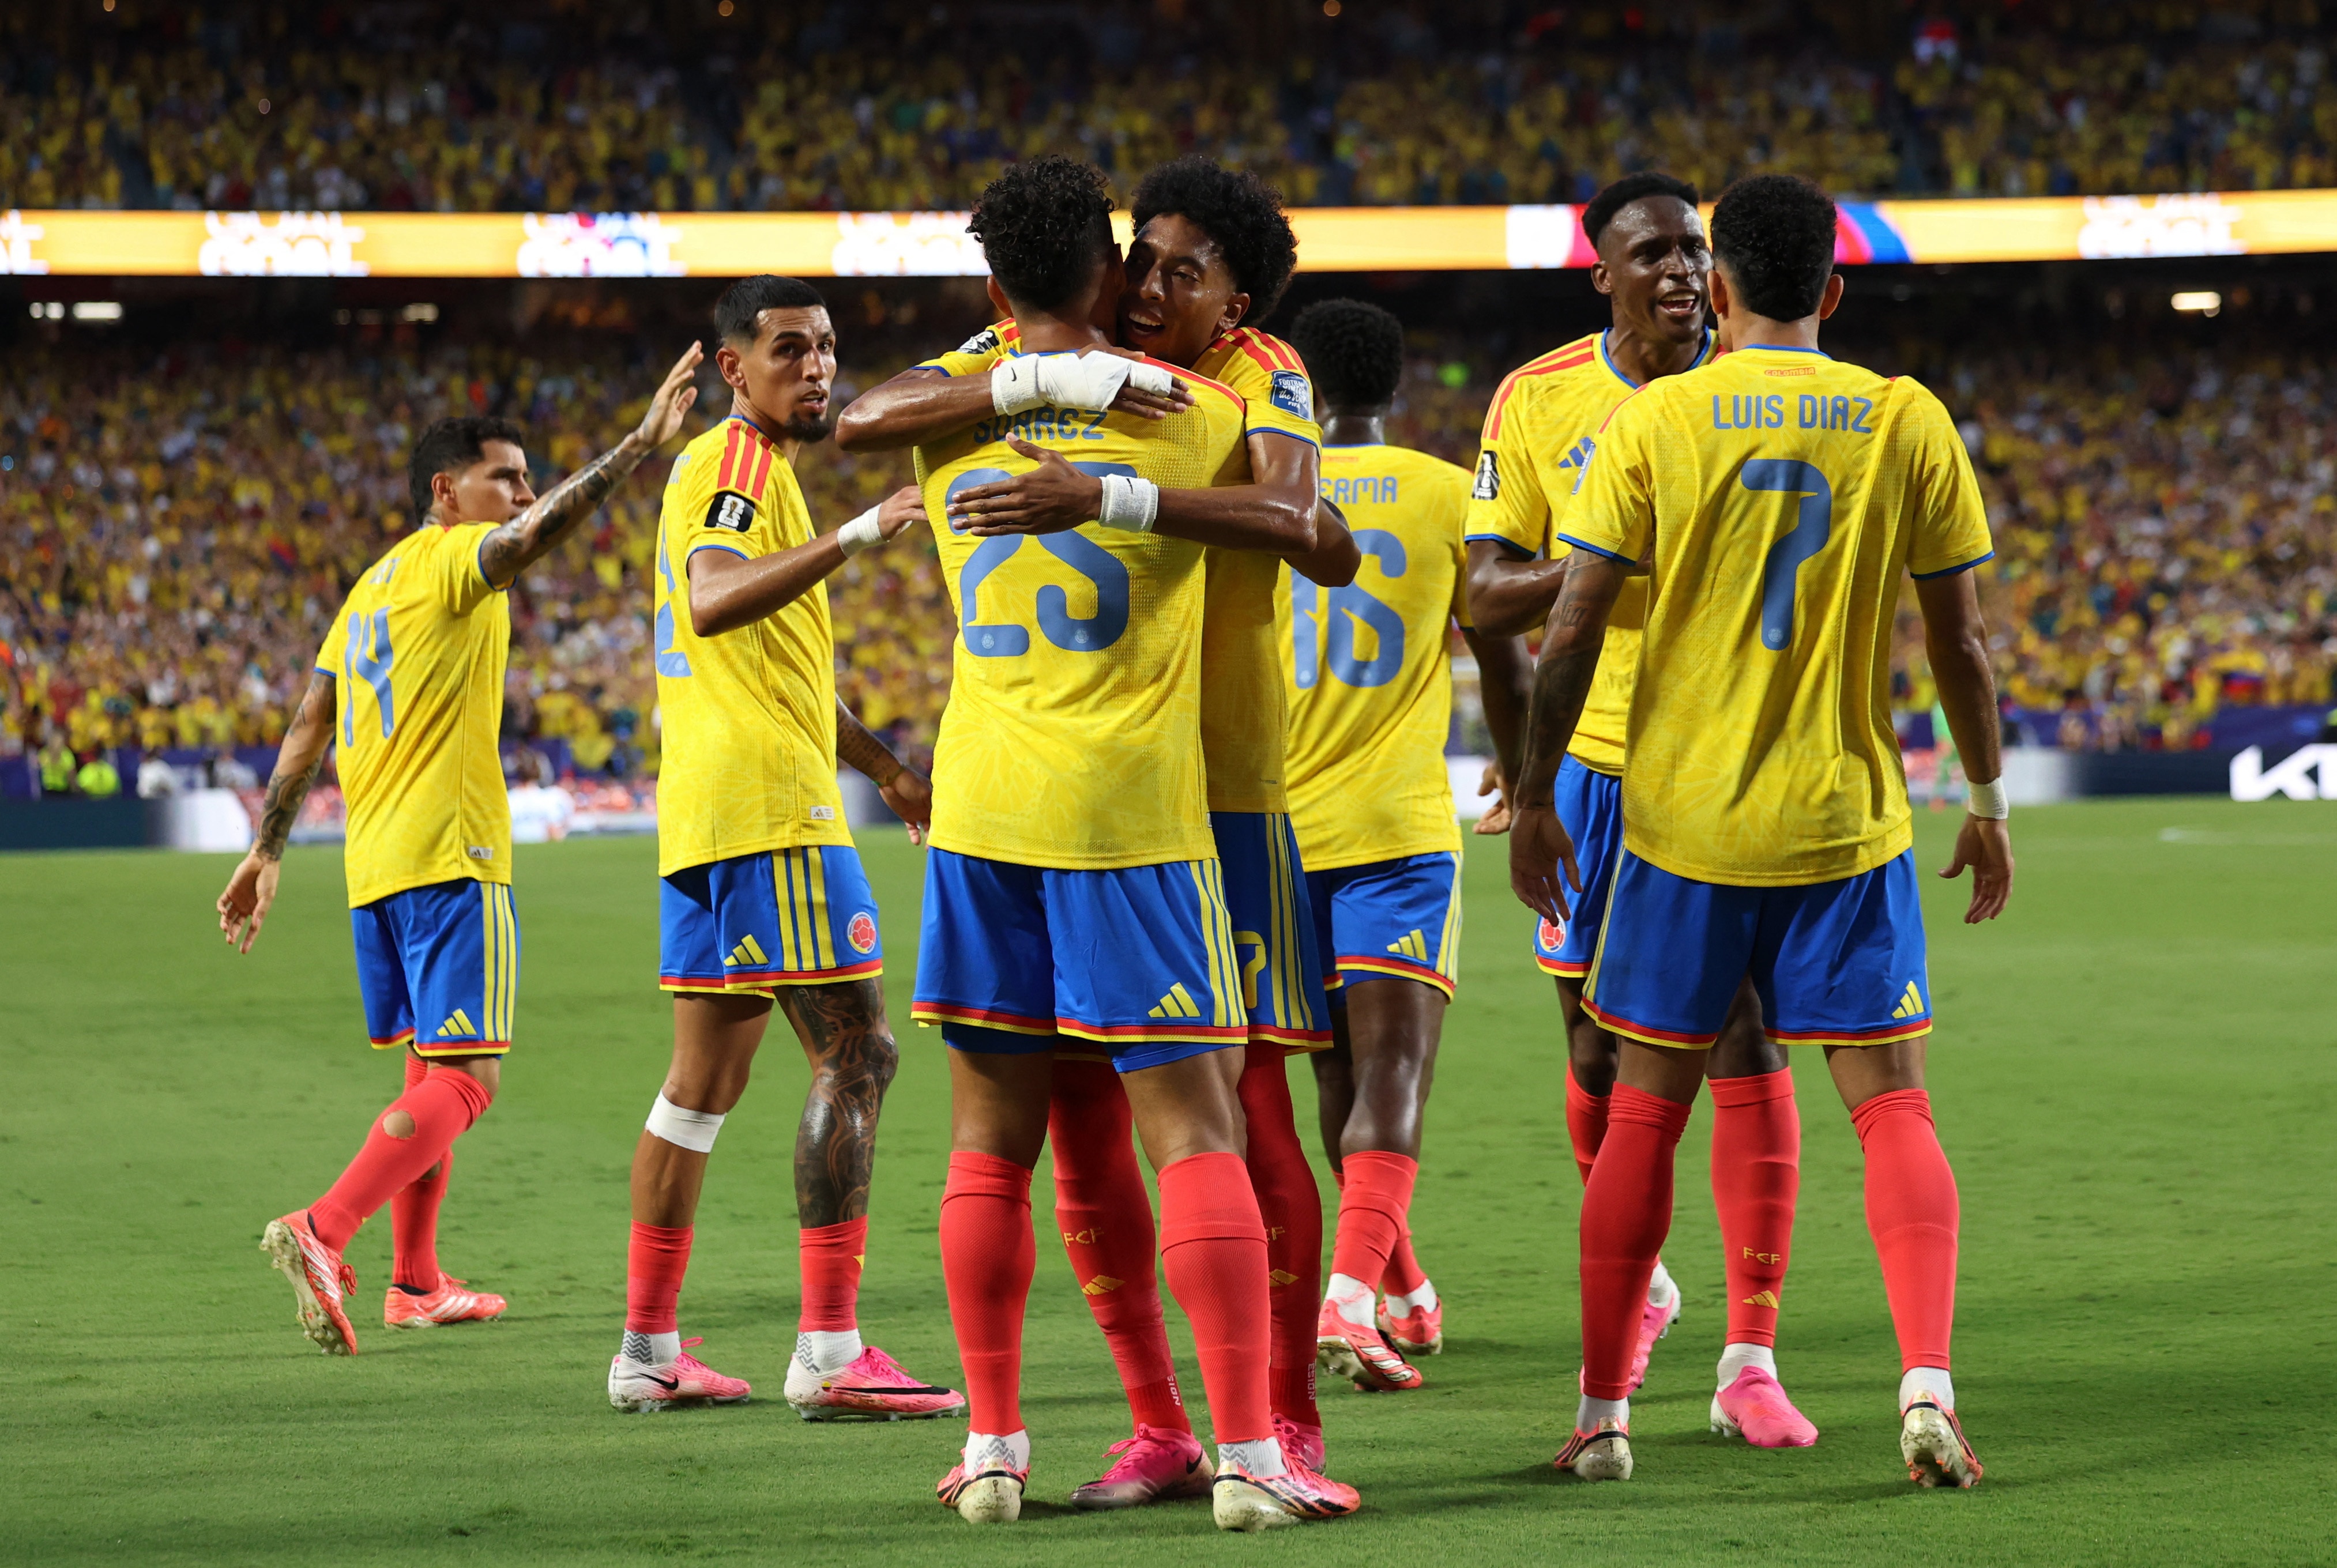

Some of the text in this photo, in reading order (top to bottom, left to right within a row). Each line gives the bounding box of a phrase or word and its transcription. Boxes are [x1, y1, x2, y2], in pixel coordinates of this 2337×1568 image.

[974, 407, 1107, 443] SUAREZ
[1713, 394, 1873, 434] LUIS DIAZ
[1320, 476, 1397, 504] ERMA
[1741, 459, 1832, 650] 7
[1292, 529, 1407, 689] 16
[344, 606, 394, 748] 14
[1232, 930, 1267, 1009] 7
[1063, 1226, 1105, 1247] FCF
[1743, 1246, 1781, 1265] FCF
[1307, 1362, 1316, 1400] ESIGN
